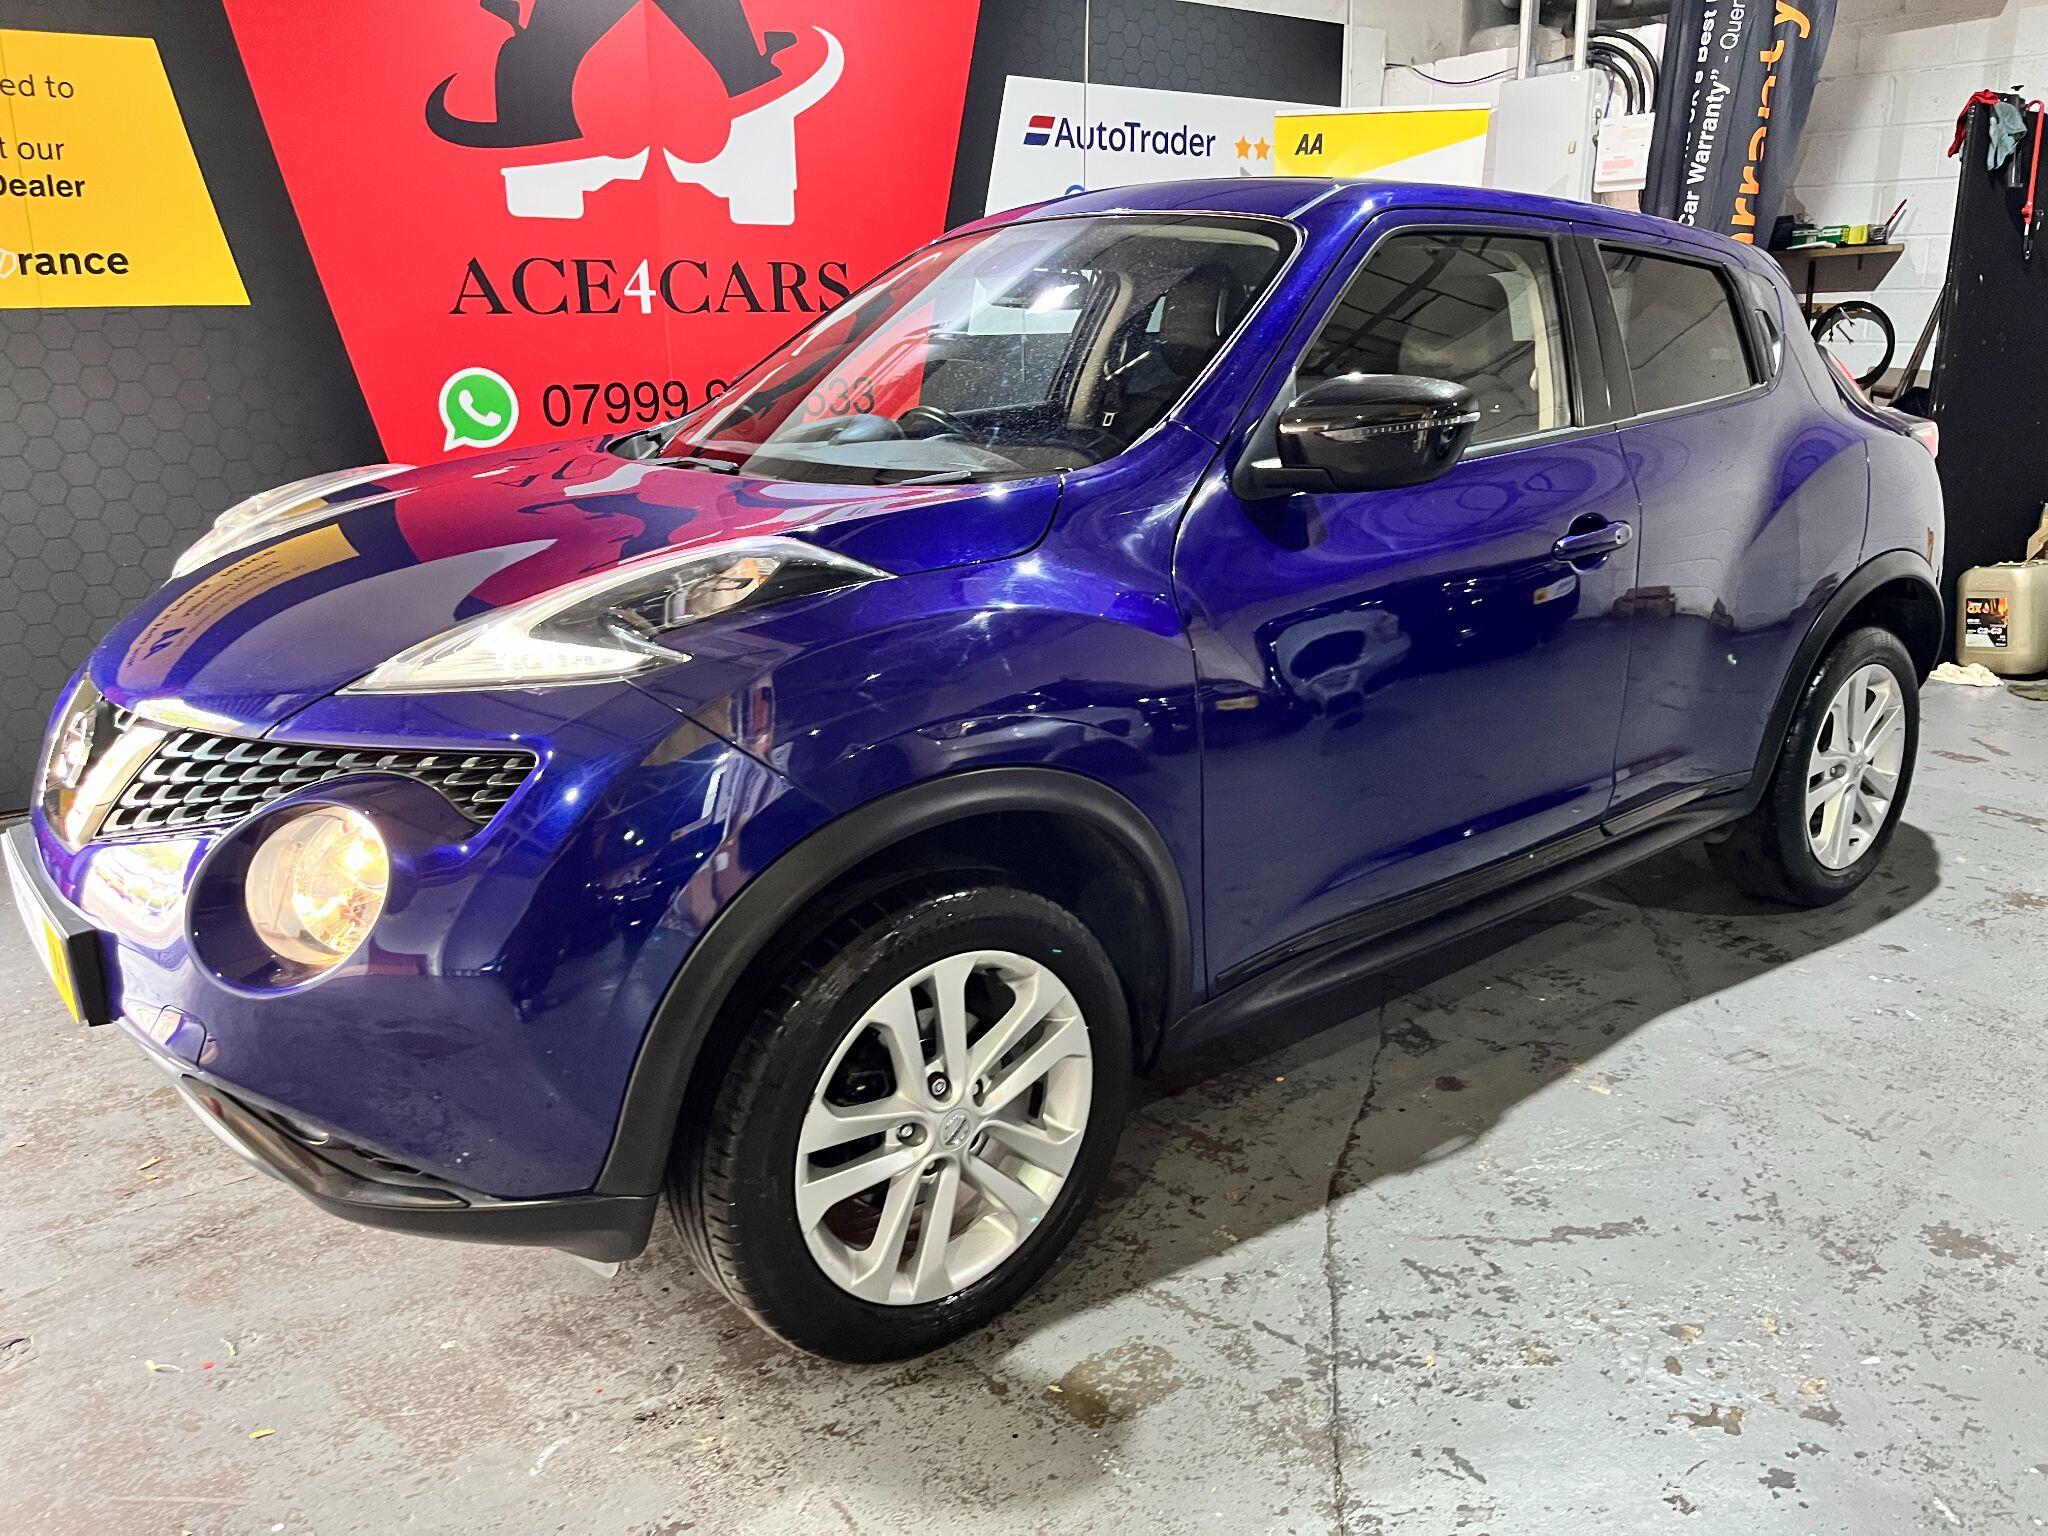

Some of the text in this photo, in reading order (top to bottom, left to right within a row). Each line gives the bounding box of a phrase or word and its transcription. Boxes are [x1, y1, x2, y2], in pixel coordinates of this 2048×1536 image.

[45, 75, 74, 99] to
[17, 141, 65, 161] our
[1054, 117, 1217, 157] AutoTrader
[1294, 133, 1324, 156] AA
[448, 256, 850, 314] ACE4CARS
[543, 380, 689, 426] 07999
